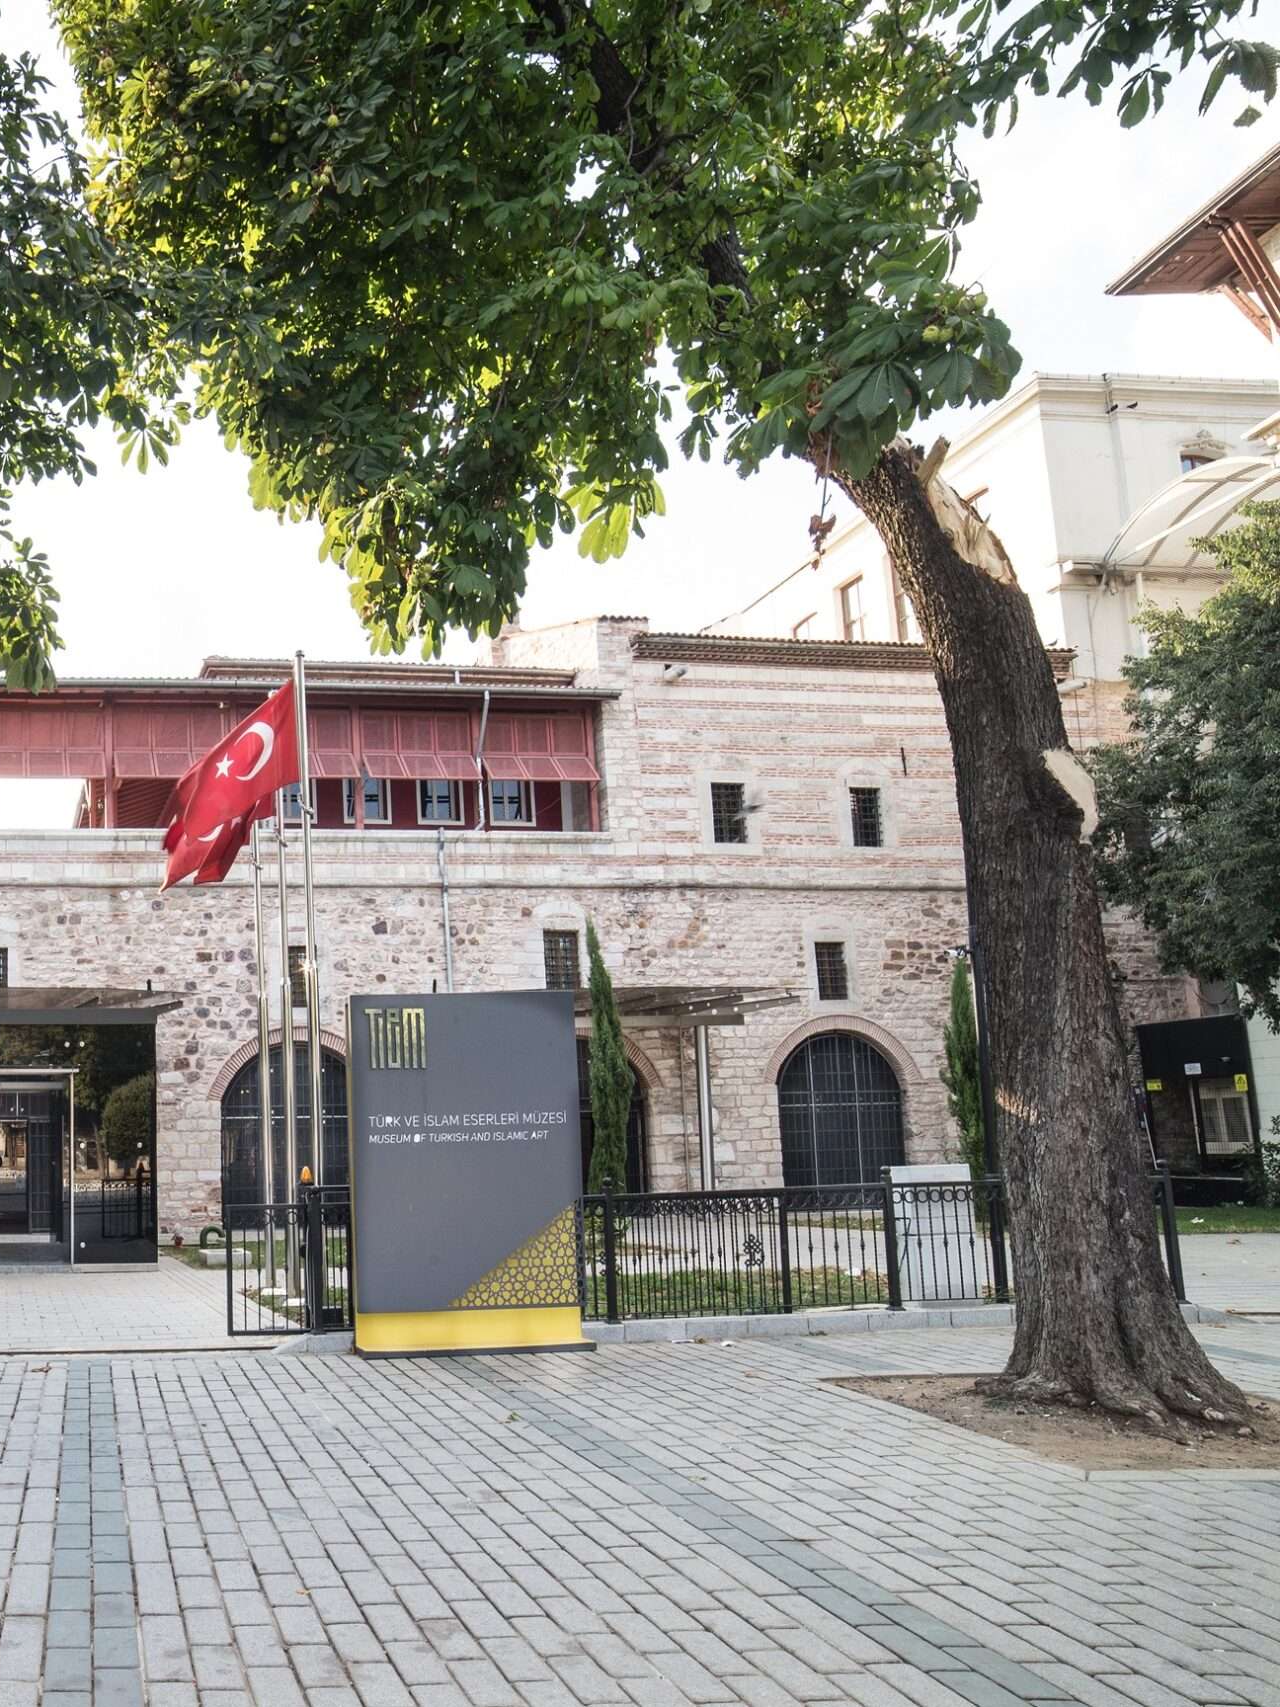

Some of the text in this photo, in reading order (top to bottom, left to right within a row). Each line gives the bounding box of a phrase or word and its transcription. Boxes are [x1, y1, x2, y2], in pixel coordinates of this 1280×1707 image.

[368, 1110, 567, 1128] TÜRK VE İSLAM ESERLERİ MÜZESİ
[368, 1130, 549, 1144] MUSEUM OF TURKISH AND ISLAMIC ART
